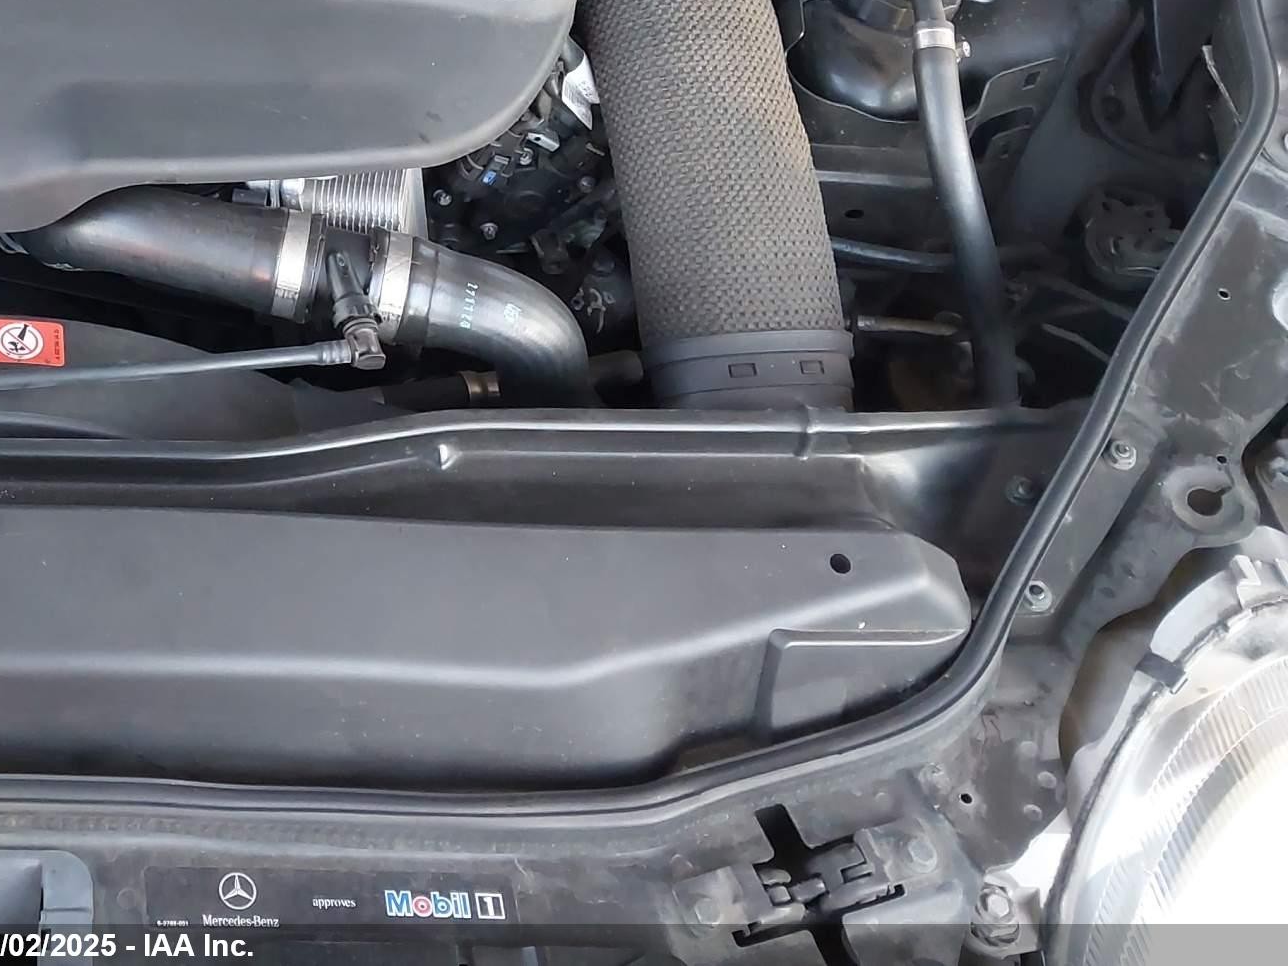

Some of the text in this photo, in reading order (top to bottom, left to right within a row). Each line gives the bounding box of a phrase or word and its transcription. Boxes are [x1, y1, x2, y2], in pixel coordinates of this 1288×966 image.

[312, 898, 357, 912] approves
[385, 890, 472, 918] Mobil
[202, 914, 280, 928] Mercedes-Benz
